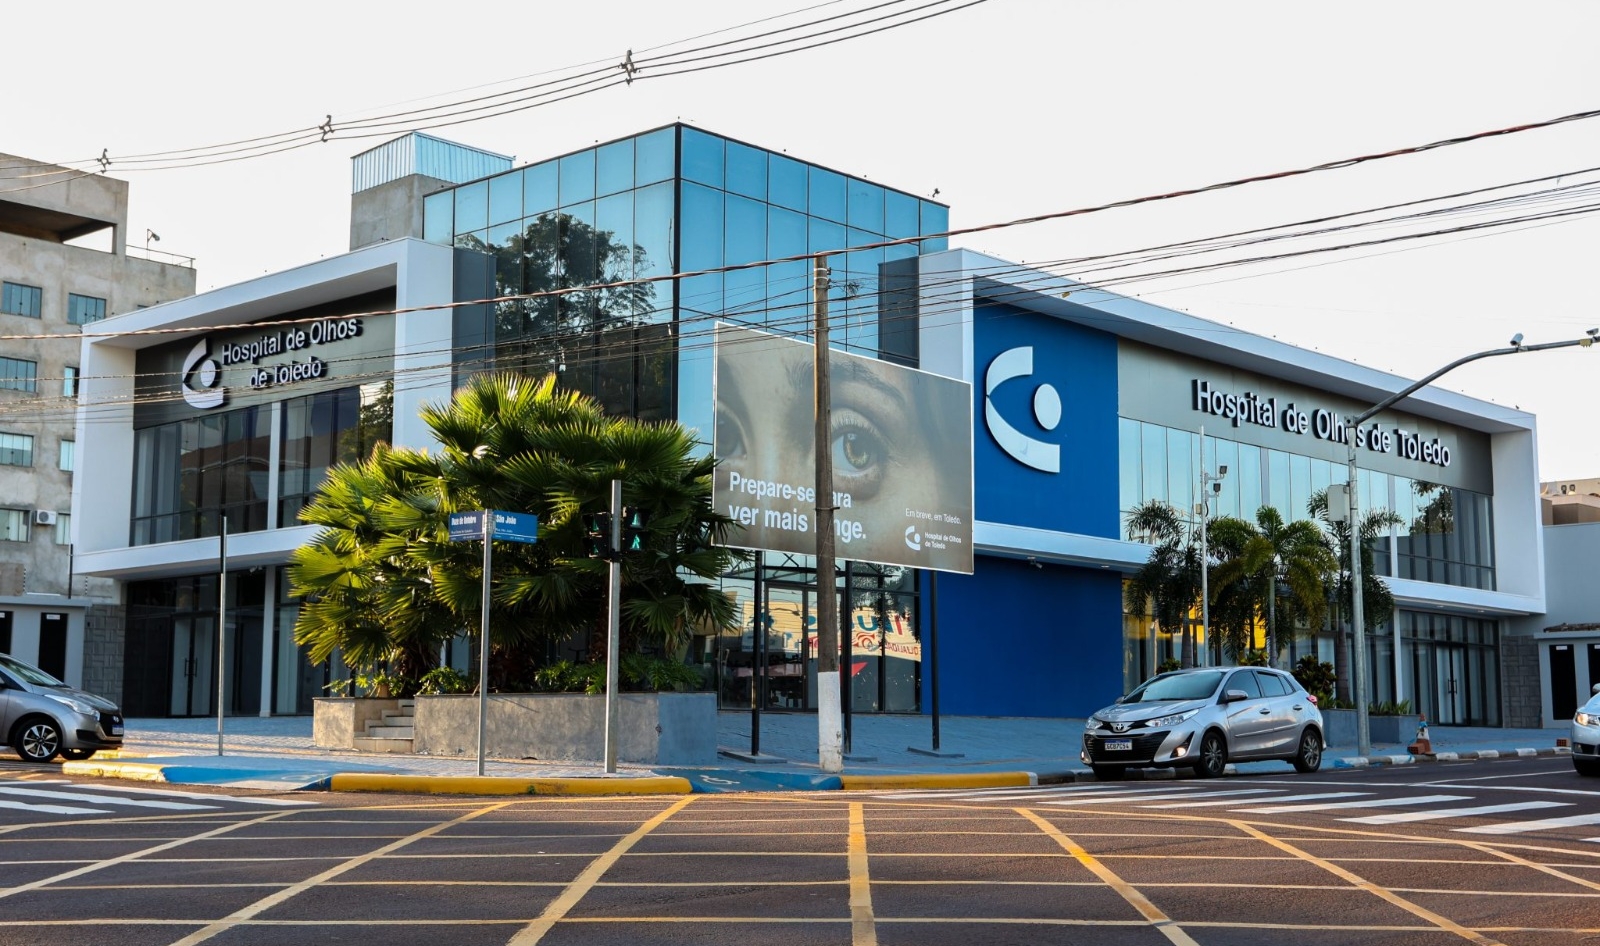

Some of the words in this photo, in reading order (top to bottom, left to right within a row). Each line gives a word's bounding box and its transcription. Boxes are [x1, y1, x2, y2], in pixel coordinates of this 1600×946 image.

[222, 332, 281, 364] Hospital
[286, 328, 306, 350] de
[310, 318, 358, 344] Olhos
[250, 367, 268, 388] de
[274, 356, 322, 383] Toledo
[1195, 379, 1278, 428] Hospital
[1284, 402, 1309, 434] de
[1314, 408, 1366, 447] Olhs
[1370, 423, 1391, 453] de
[1396, 428, 1451, 467] Toledo
[729, 471, 816, 503] Prepare-se
[832, 491, 852, 508] ara
[728, 504, 760, 526] ver
[764, 508, 809, 532] mais
[814, 511, 867, 543] lnge.
[905, 508, 916, 517] Em
[916, 510, 933, 521] breve,
[943, 513, 962, 525] Toledo.
[924, 531, 943, 541] Hospital
[943, 534, 949, 542] de
[949, 535, 962, 544] Olhos
[931, 541, 946, 549] Toledo
